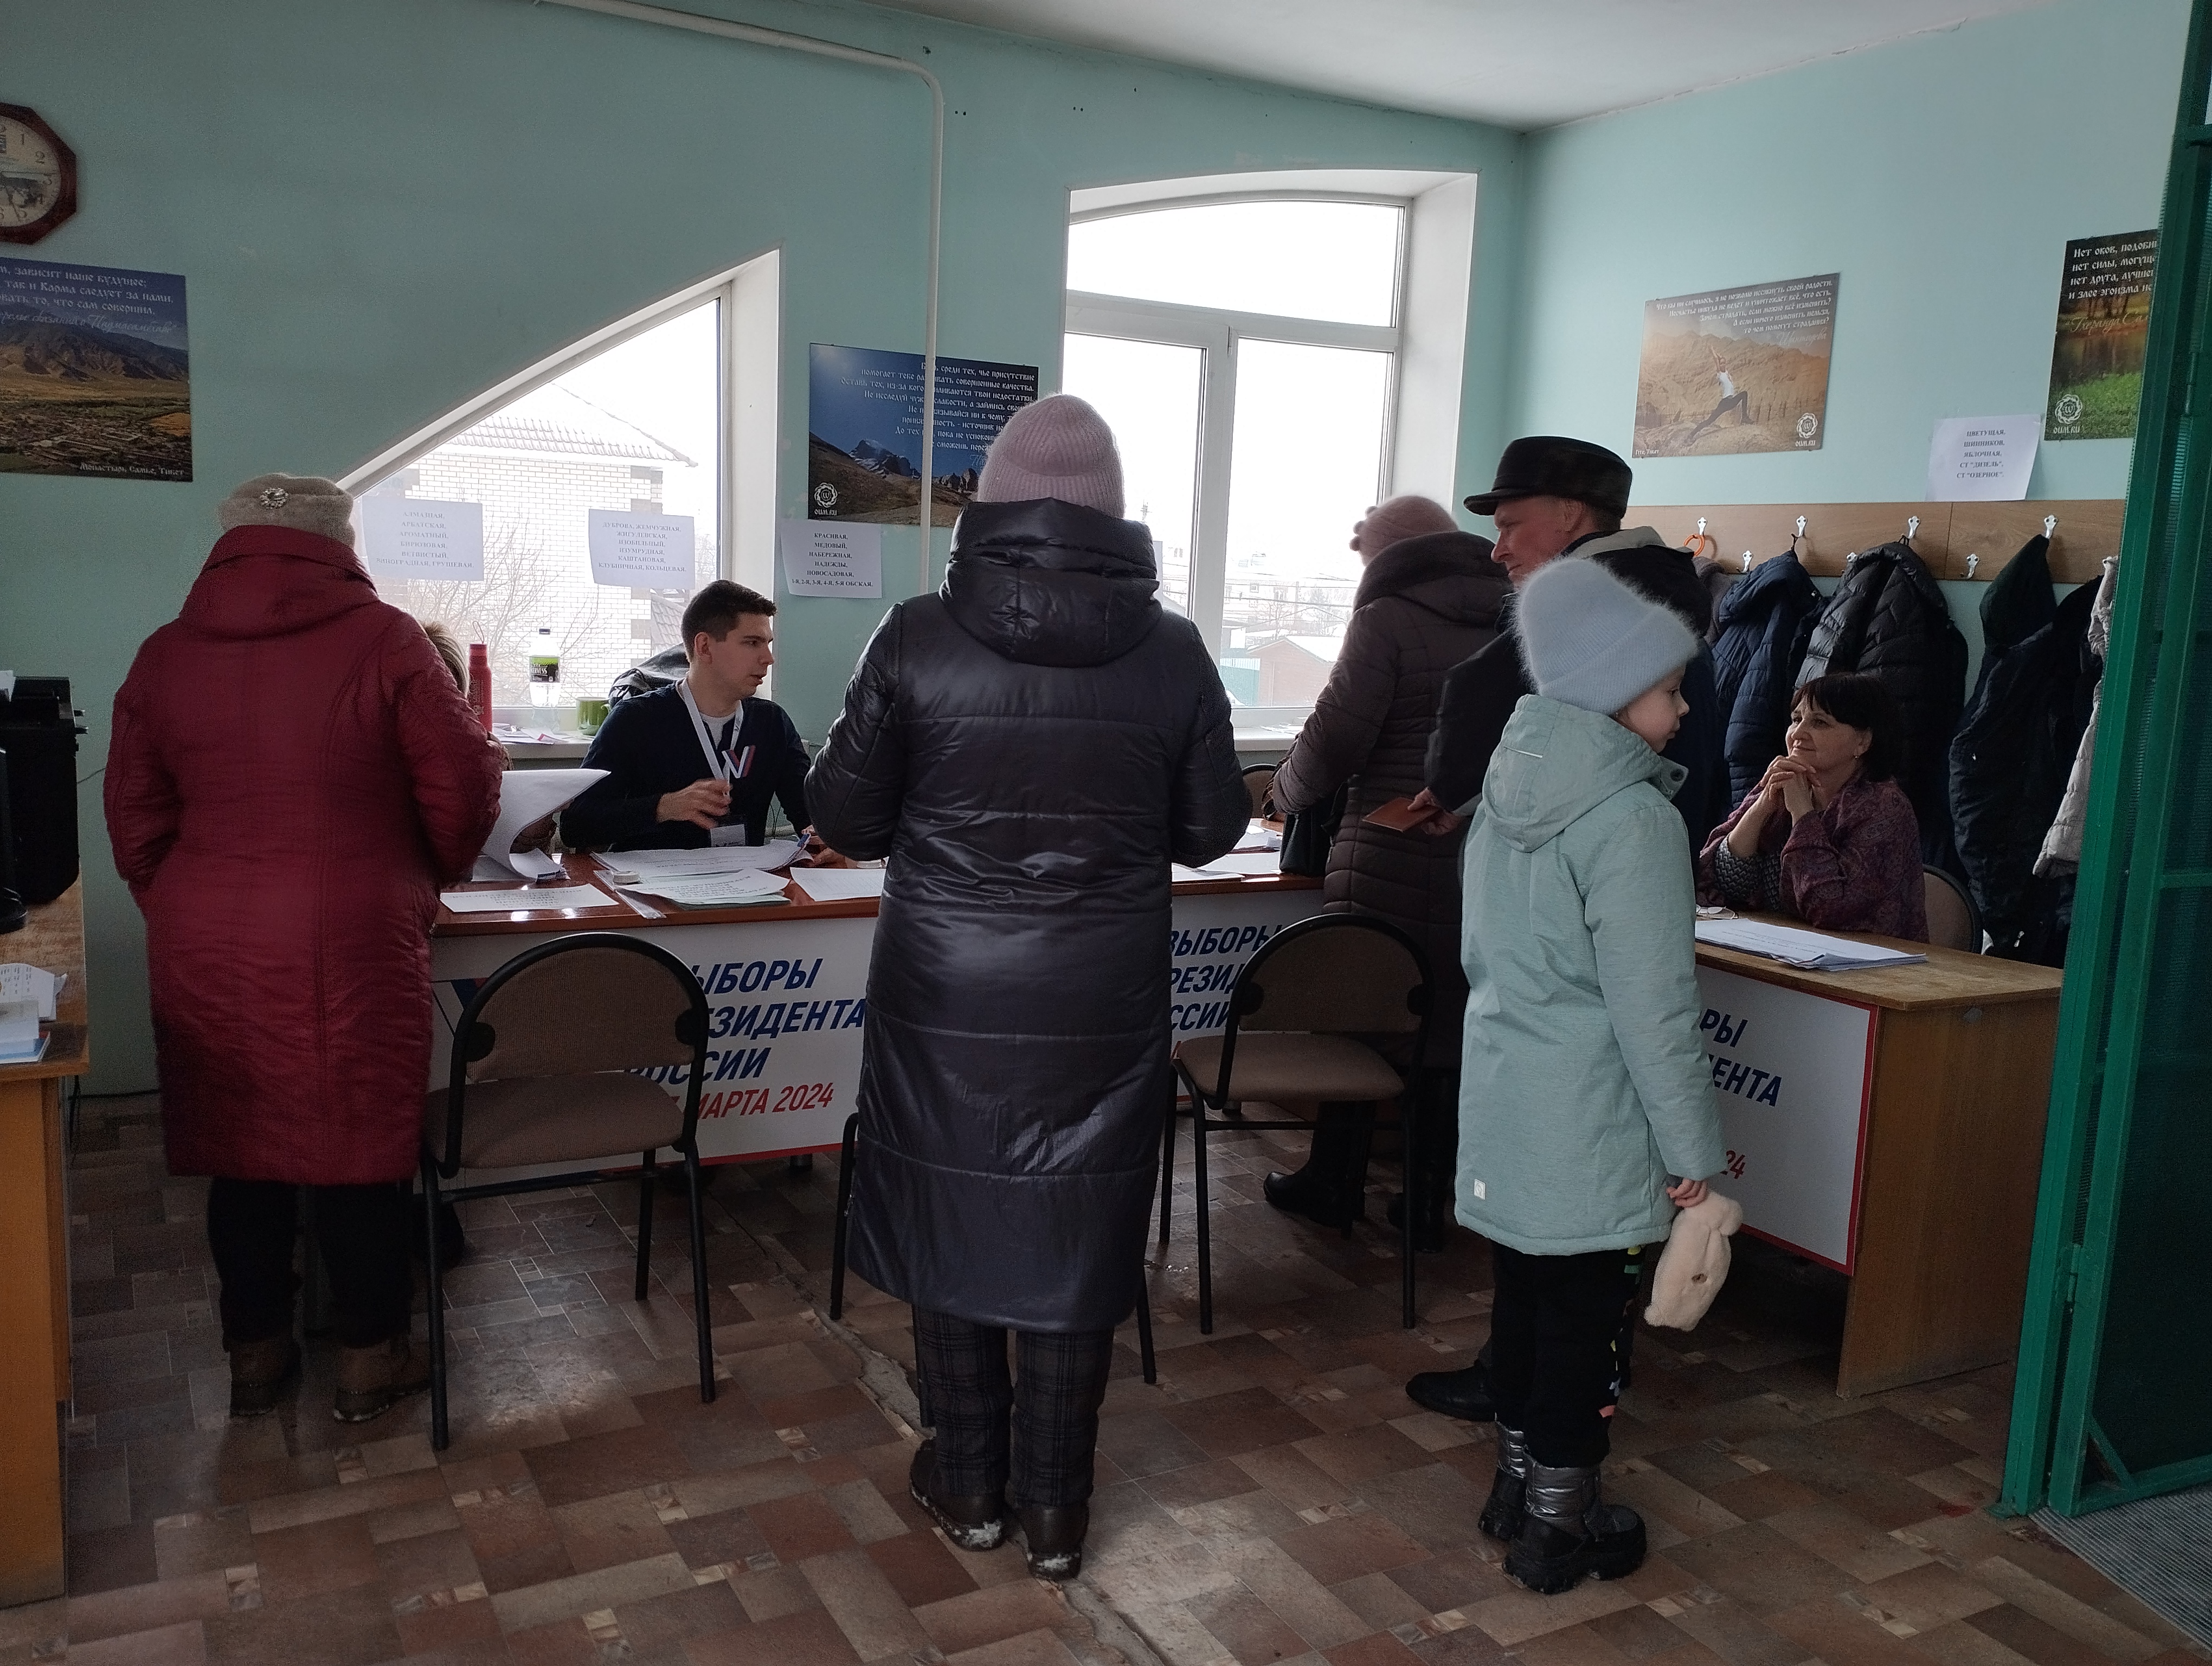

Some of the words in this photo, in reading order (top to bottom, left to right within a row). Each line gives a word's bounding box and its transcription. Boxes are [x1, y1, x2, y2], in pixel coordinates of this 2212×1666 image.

[21, 133, 25, 145] 1
[35, 150, 45, 164] 2
[2074, 248, 2092, 258] Нет
[2094, 246, 2118, 255] оков,
[2072, 262, 2089, 272] нет
[2092, 260, 2117, 270] силы,
[15, 266, 61, 279] зависит
[66, 272, 93, 282] наше
[98, 275, 147, 287] будущее;
[2070, 277, 2088, 286] нет
[2089, 273, 2119, 285] друга,
[5, 280, 25, 289] так
[29, 282, 36, 290] и
[40, 282, 76, 294] Карма
[80, 287, 123, 299] следует
[126, 291, 139, 300] за
[1685, 298, 1714, 307] случилось,
[1786, 284, 1804, 292] своей
[2077, 290, 2098, 299] злее
[2100, 285, 2139, 296] эгоизма
[34, 297, 50, 306] то,
[53, 298, 74, 308] что
[77, 300, 98, 310] сам
[101, 303, 156, 315] совершил.
[1698, 306, 1718, 315] никуда
[1751, 297, 1787, 306] уничтожает
[1699, 314, 1717, 322] Зачем
[1753, 316, 1773, 324] ничего
[1774, 312, 1805, 321] изменить
[1765, 323, 1791, 332] помогут
[941, 366, 960, 374] среди
[962, 368, 976, 376] тех,
[992, 371, 1035, 381] присутствие
[861, 369, 896, 378] помогает
[898, 372, 915, 380] тебе
[956, 378, 1000, 388] совершенные
[1002, 383, 1034, 392] качества.
[870, 381, 884, 389] тех,
[887, 382, 906, 390] из-за
[909, 384, 924, 392] кого
[974, 390, 991, 399] твои
[864, 390, 873, 398] Не
[876, 393, 908, 403] исследуй
[934, 398, 967, 407] слабости,
[976, 401, 1005, 411] займись
[908, 405, 917, 413] Не
[988, 414, 1006, 423] чему,
[895, 426, 905, 435] До
[962, 422, 994, 431] источник
[936, 441, 968, 450] сможешь
[401, 521, 446, 529] АРБАТСКАЯ,
[617, 531, 668, 540] ЖИГУЛЕВСКАЯ,
[619, 539, 666, 547] ИЗОБИЛЬНЫЙ,
[402, 551, 449, 559] ВЕТВИСТЫЙ,
[376, 558, 431, 567] ВИНОГРАДНАЯ,
[599, 562, 644, 571] КЛУБНИЧНАЯ,
[690, 959, 822, 996] ЫБОРЫ
[771, 1082, 834, 1113] 2024
